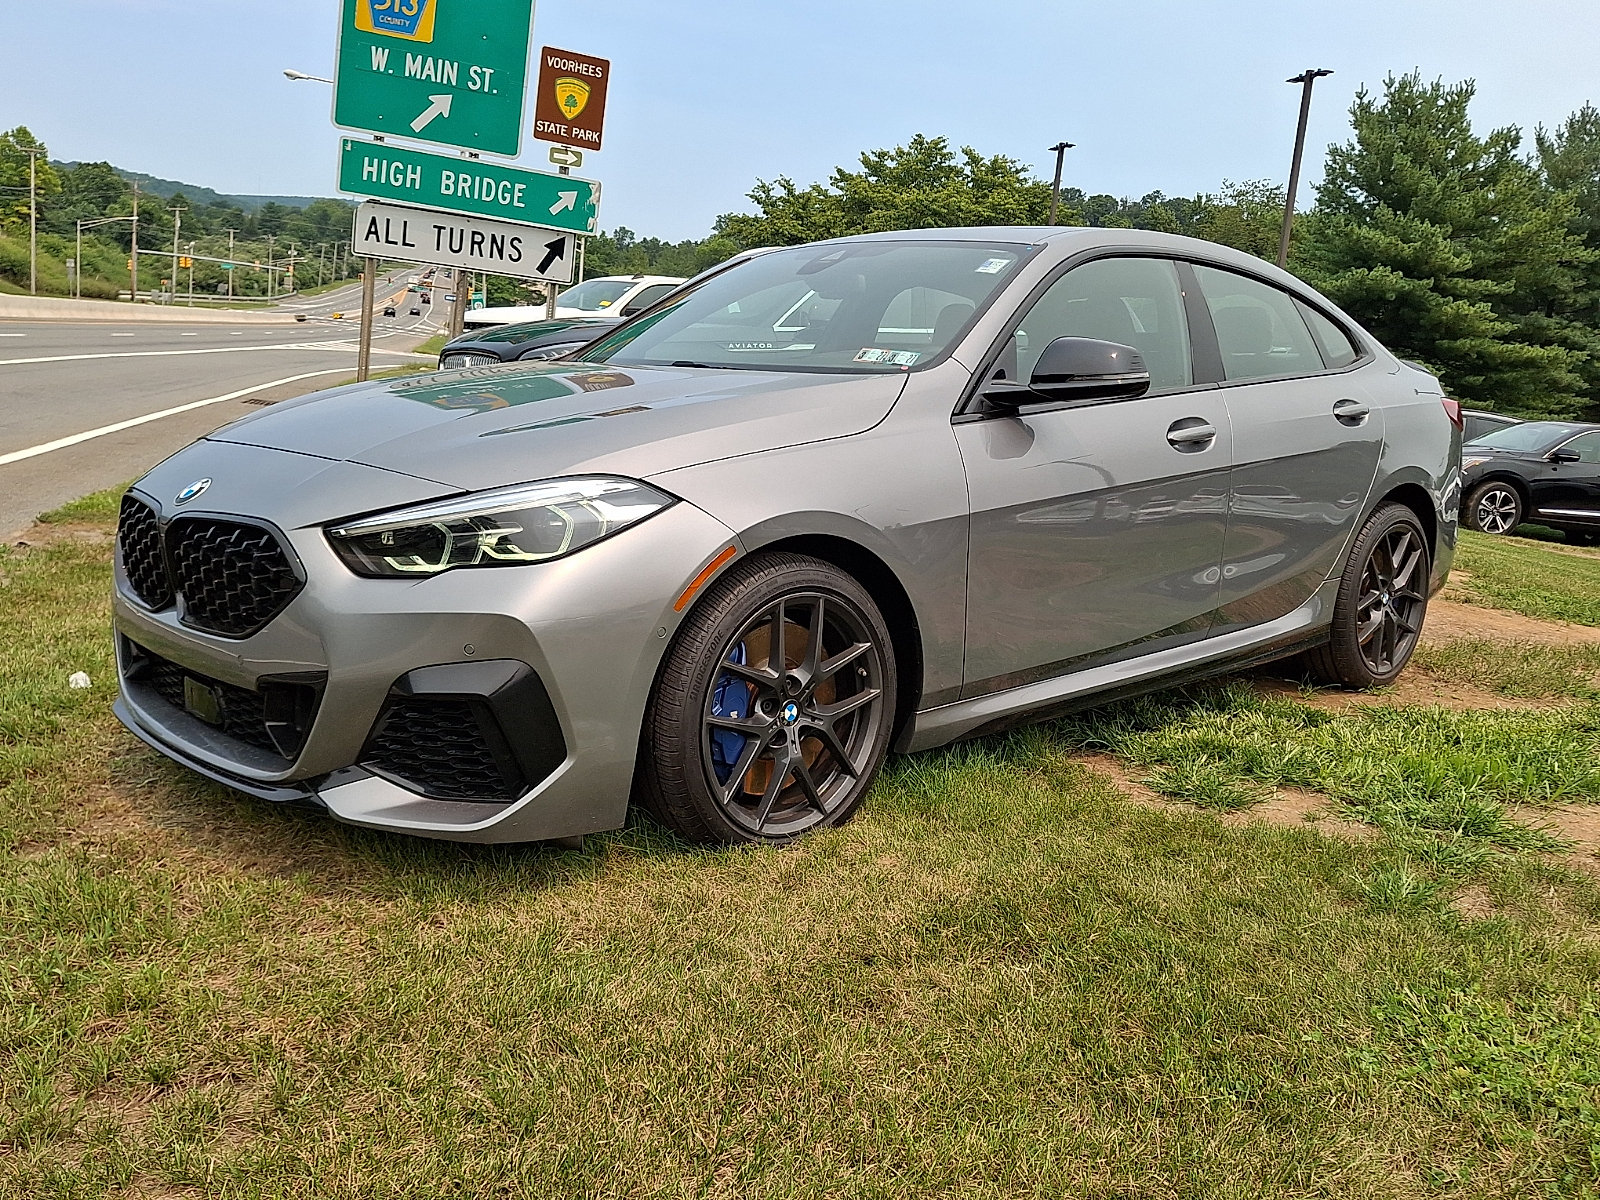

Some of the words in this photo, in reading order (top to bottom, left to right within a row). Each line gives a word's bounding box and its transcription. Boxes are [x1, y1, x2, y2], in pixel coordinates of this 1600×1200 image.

[379, 15, 410, 27] COUNTY
[371, 46, 394, 74] W.
[404, 53, 459, 86] MAIN
[467, 66, 498, 94] ST.
[547, 55, 603, 78] VOORHEES
[536, 120, 569, 137] STATE
[572, 127, 600, 143] PARK
[362, 157, 421, 189] HIGH
[440, 171, 527, 208] BRIDGE
[364, 216, 415, 248] ALL
[432, 224, 523, 262] TURNS
